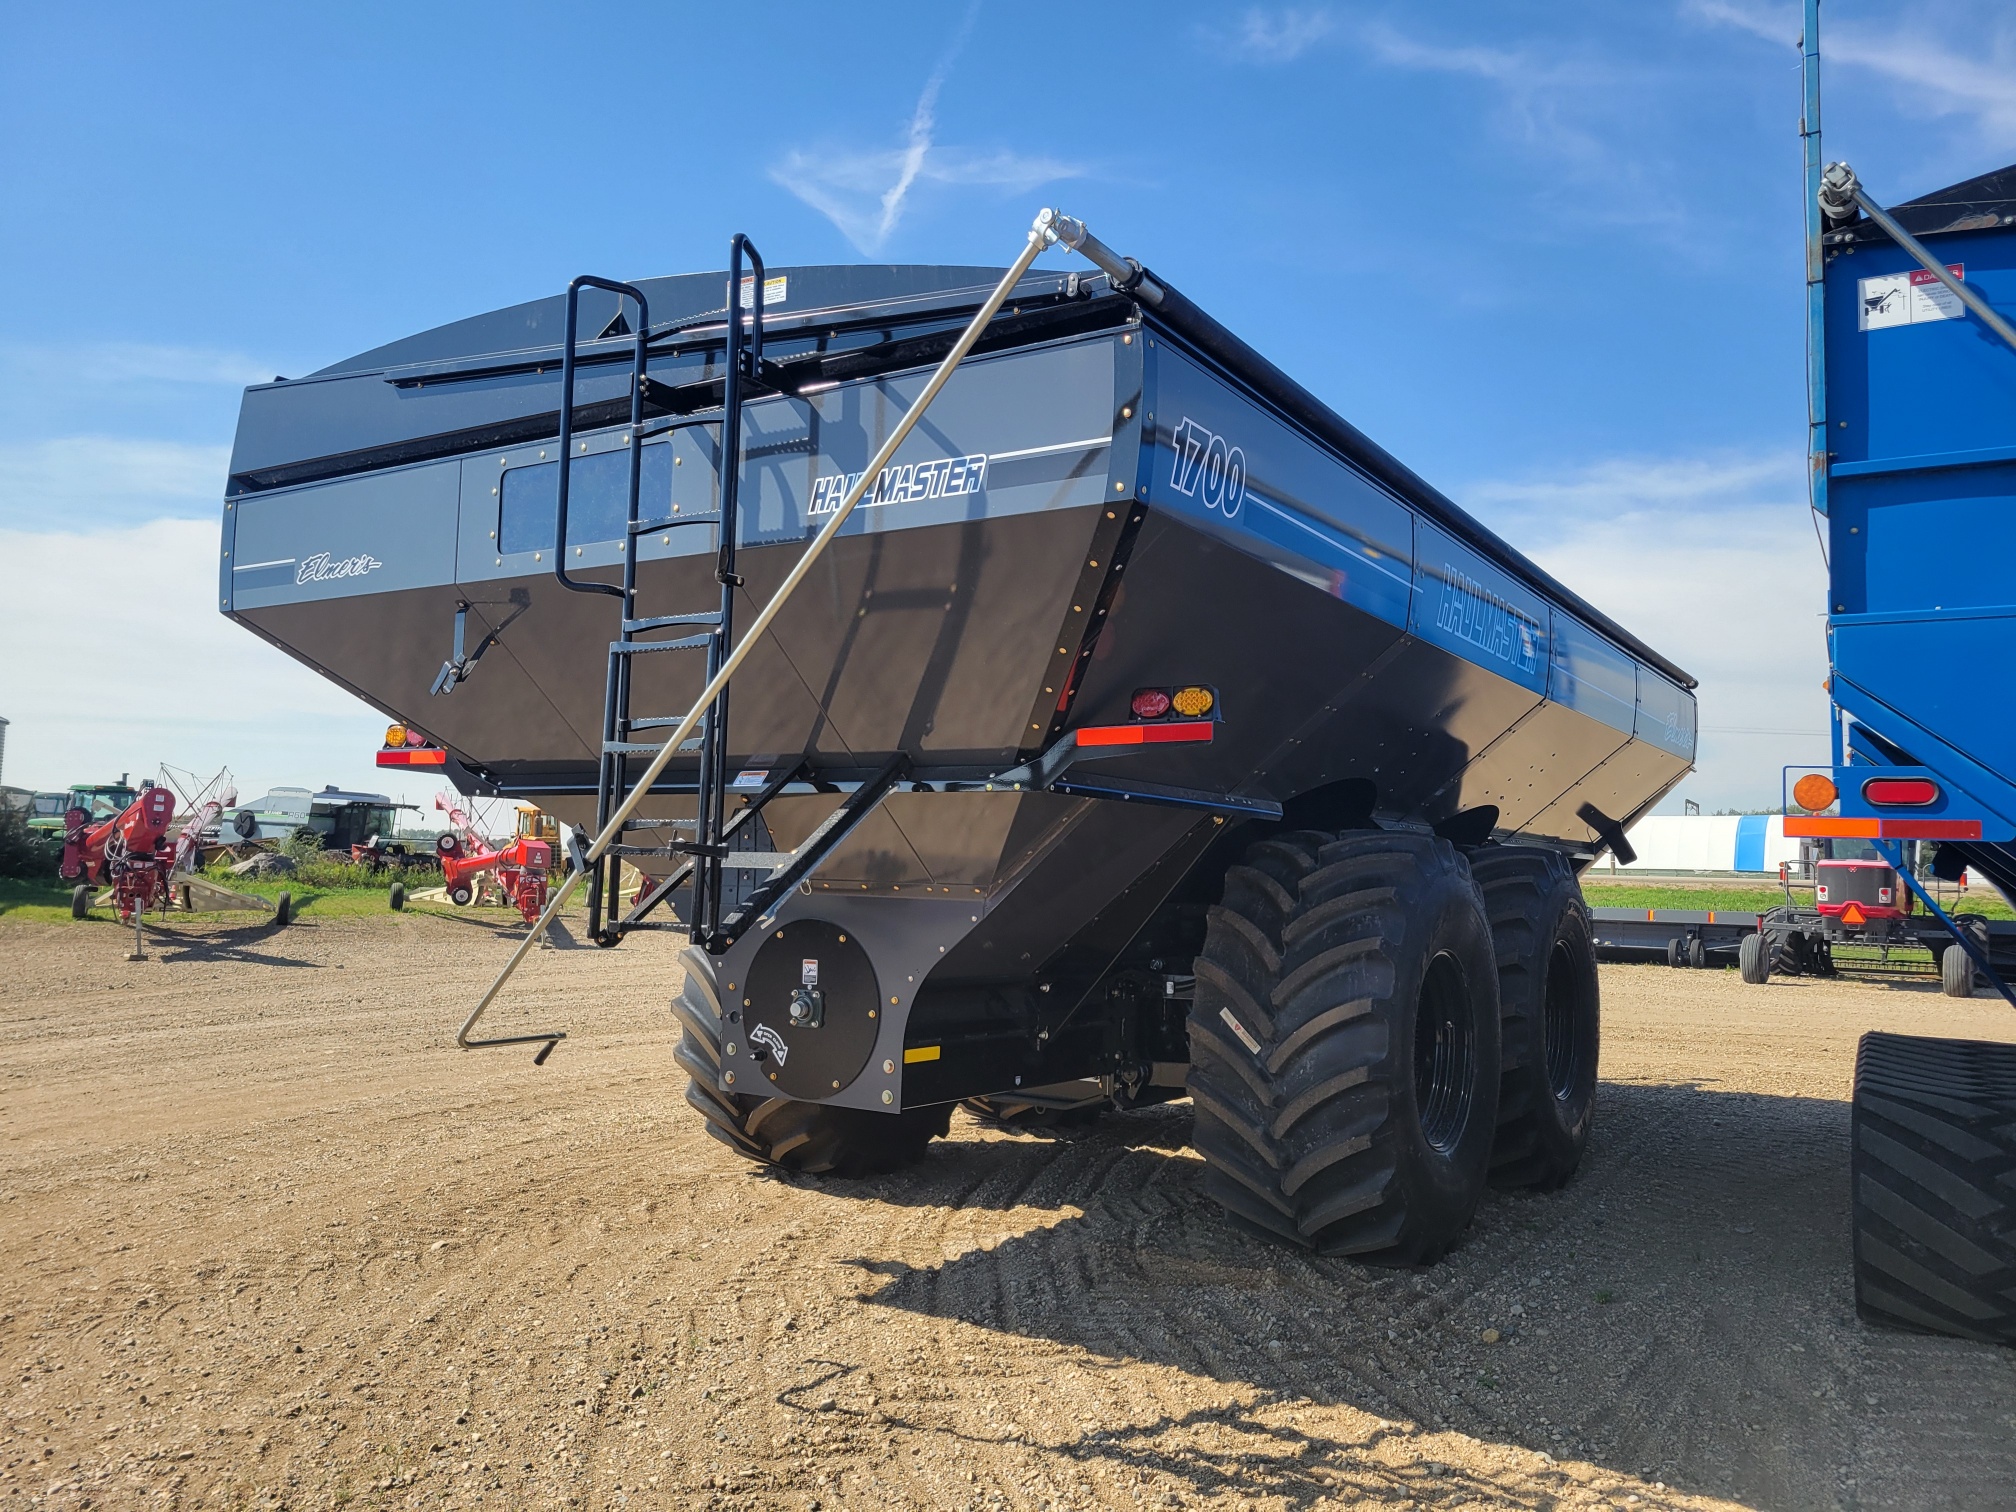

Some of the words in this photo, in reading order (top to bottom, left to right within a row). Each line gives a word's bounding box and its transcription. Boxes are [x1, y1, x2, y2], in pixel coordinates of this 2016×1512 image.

[1923, 269, 1959, 281] DAR
[1170, 416, 1246, 519] 1700
[296, 551, 383, 585] Elmer's
